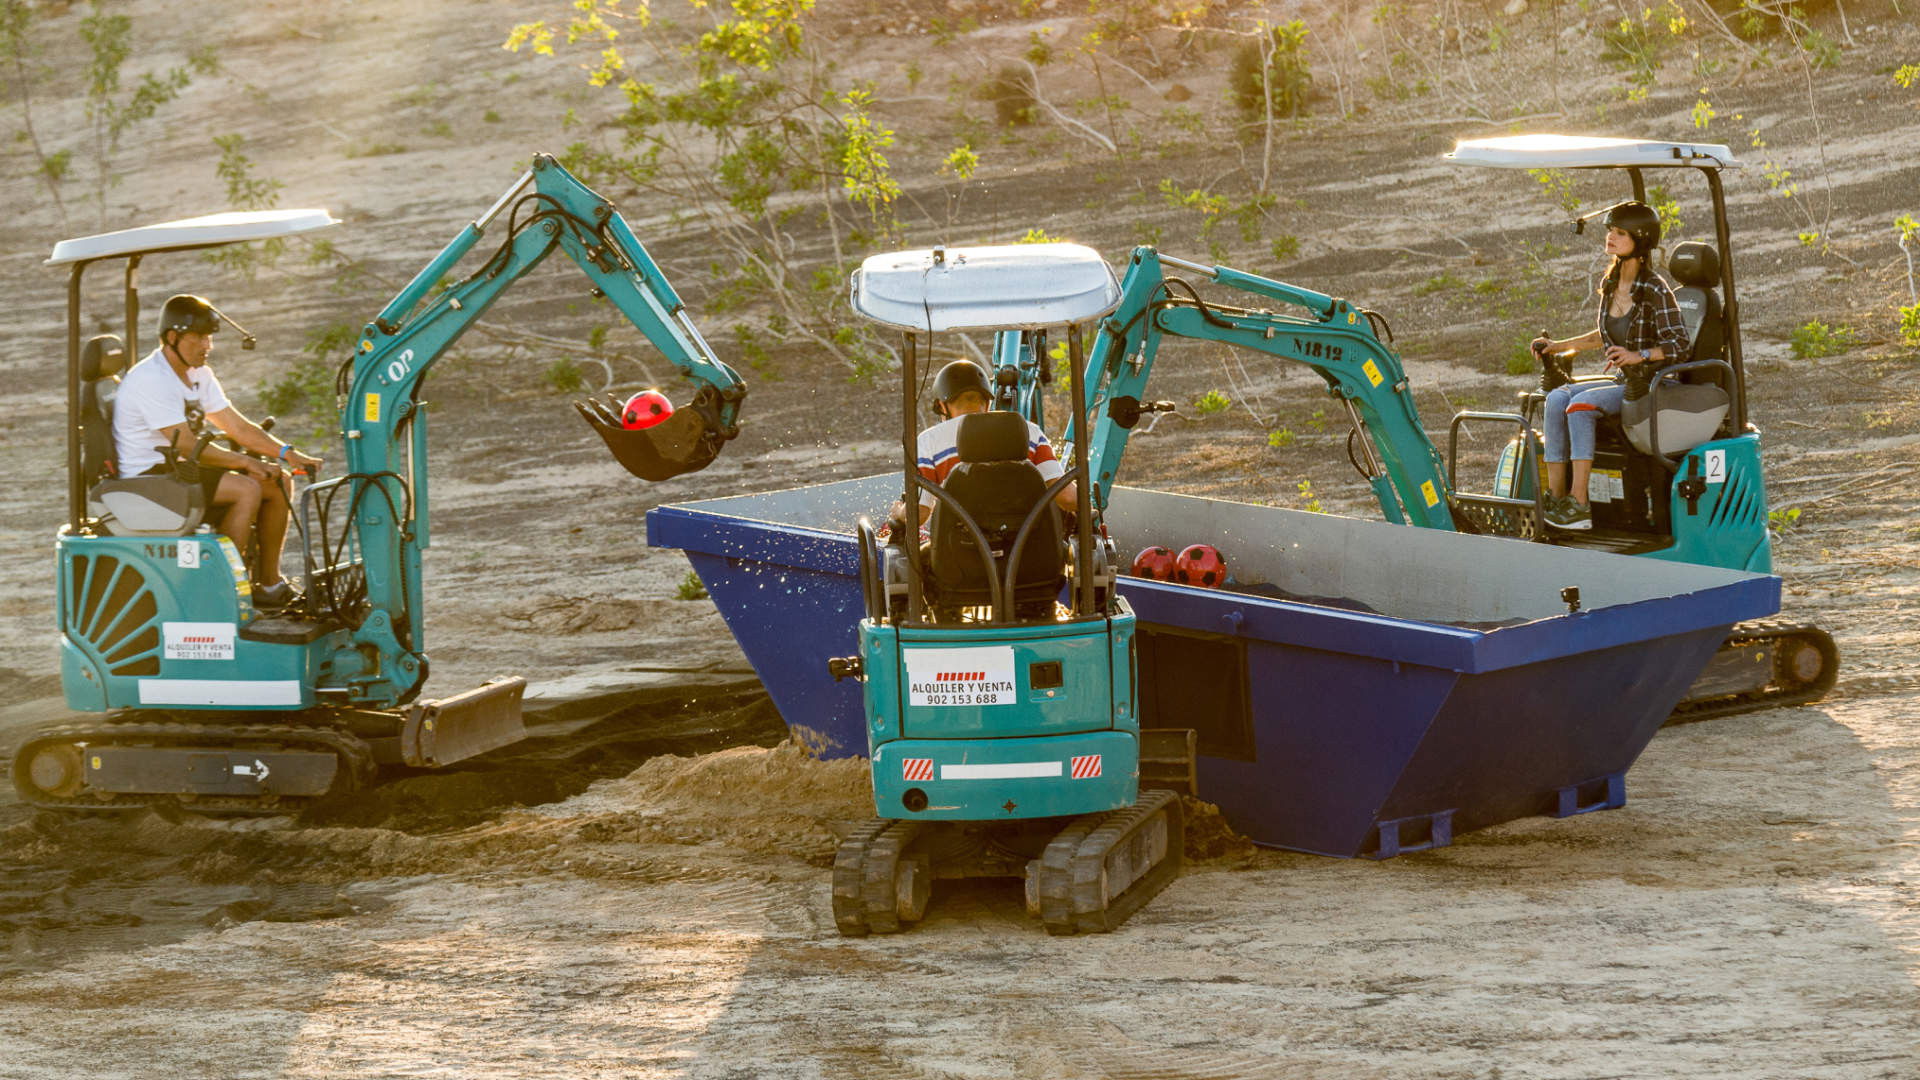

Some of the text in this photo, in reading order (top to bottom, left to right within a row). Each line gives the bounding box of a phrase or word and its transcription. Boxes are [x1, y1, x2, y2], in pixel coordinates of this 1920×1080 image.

[1293, 337, 1343, 361] N1812
[1710, 455, 1721, 477] 2
[182, 543, 195, 565] 3
[167, 644, 201, 652] ALQUILER
[912, 681, 1013, 693] ALQUILER Y VENTA
[927, 693, 997, 704] 902 153 688
